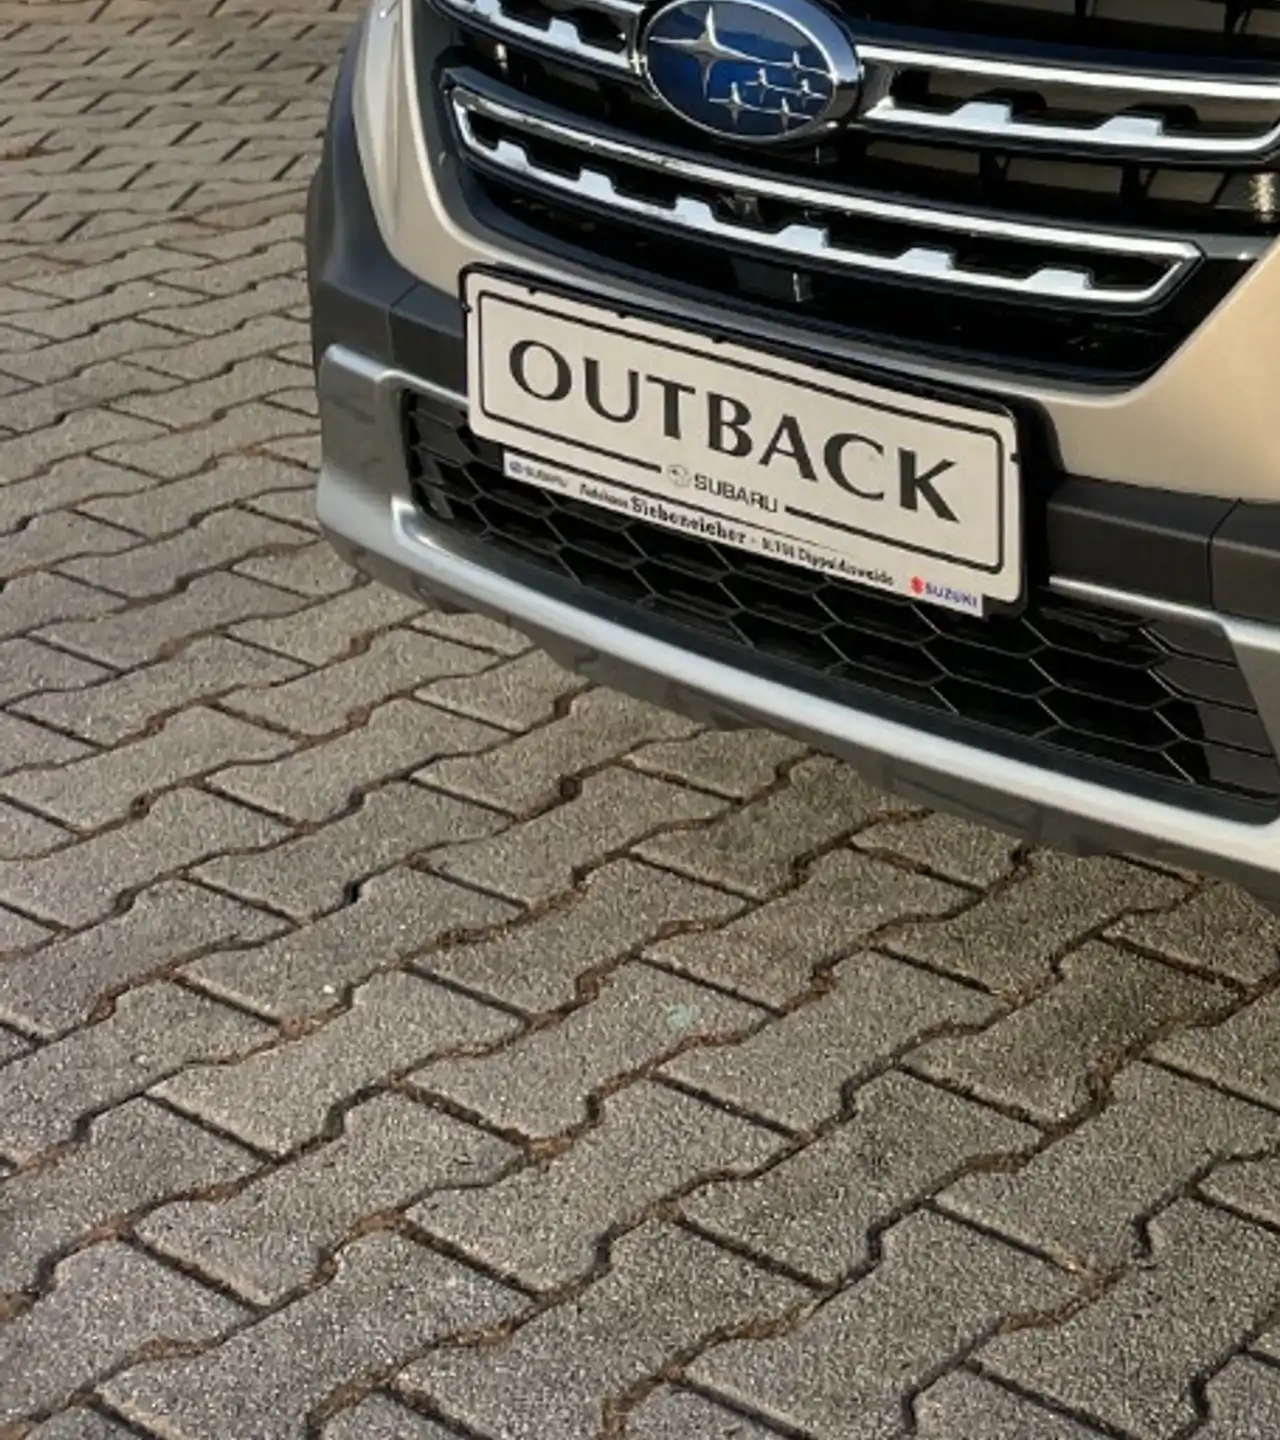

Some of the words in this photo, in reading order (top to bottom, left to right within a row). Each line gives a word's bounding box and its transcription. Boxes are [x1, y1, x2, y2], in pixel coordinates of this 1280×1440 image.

[508, 340, 961, 524] OUTBACK
[693, 472, 779, 515] SUBARU
[925, 581, 979, 608] SUZUKI
